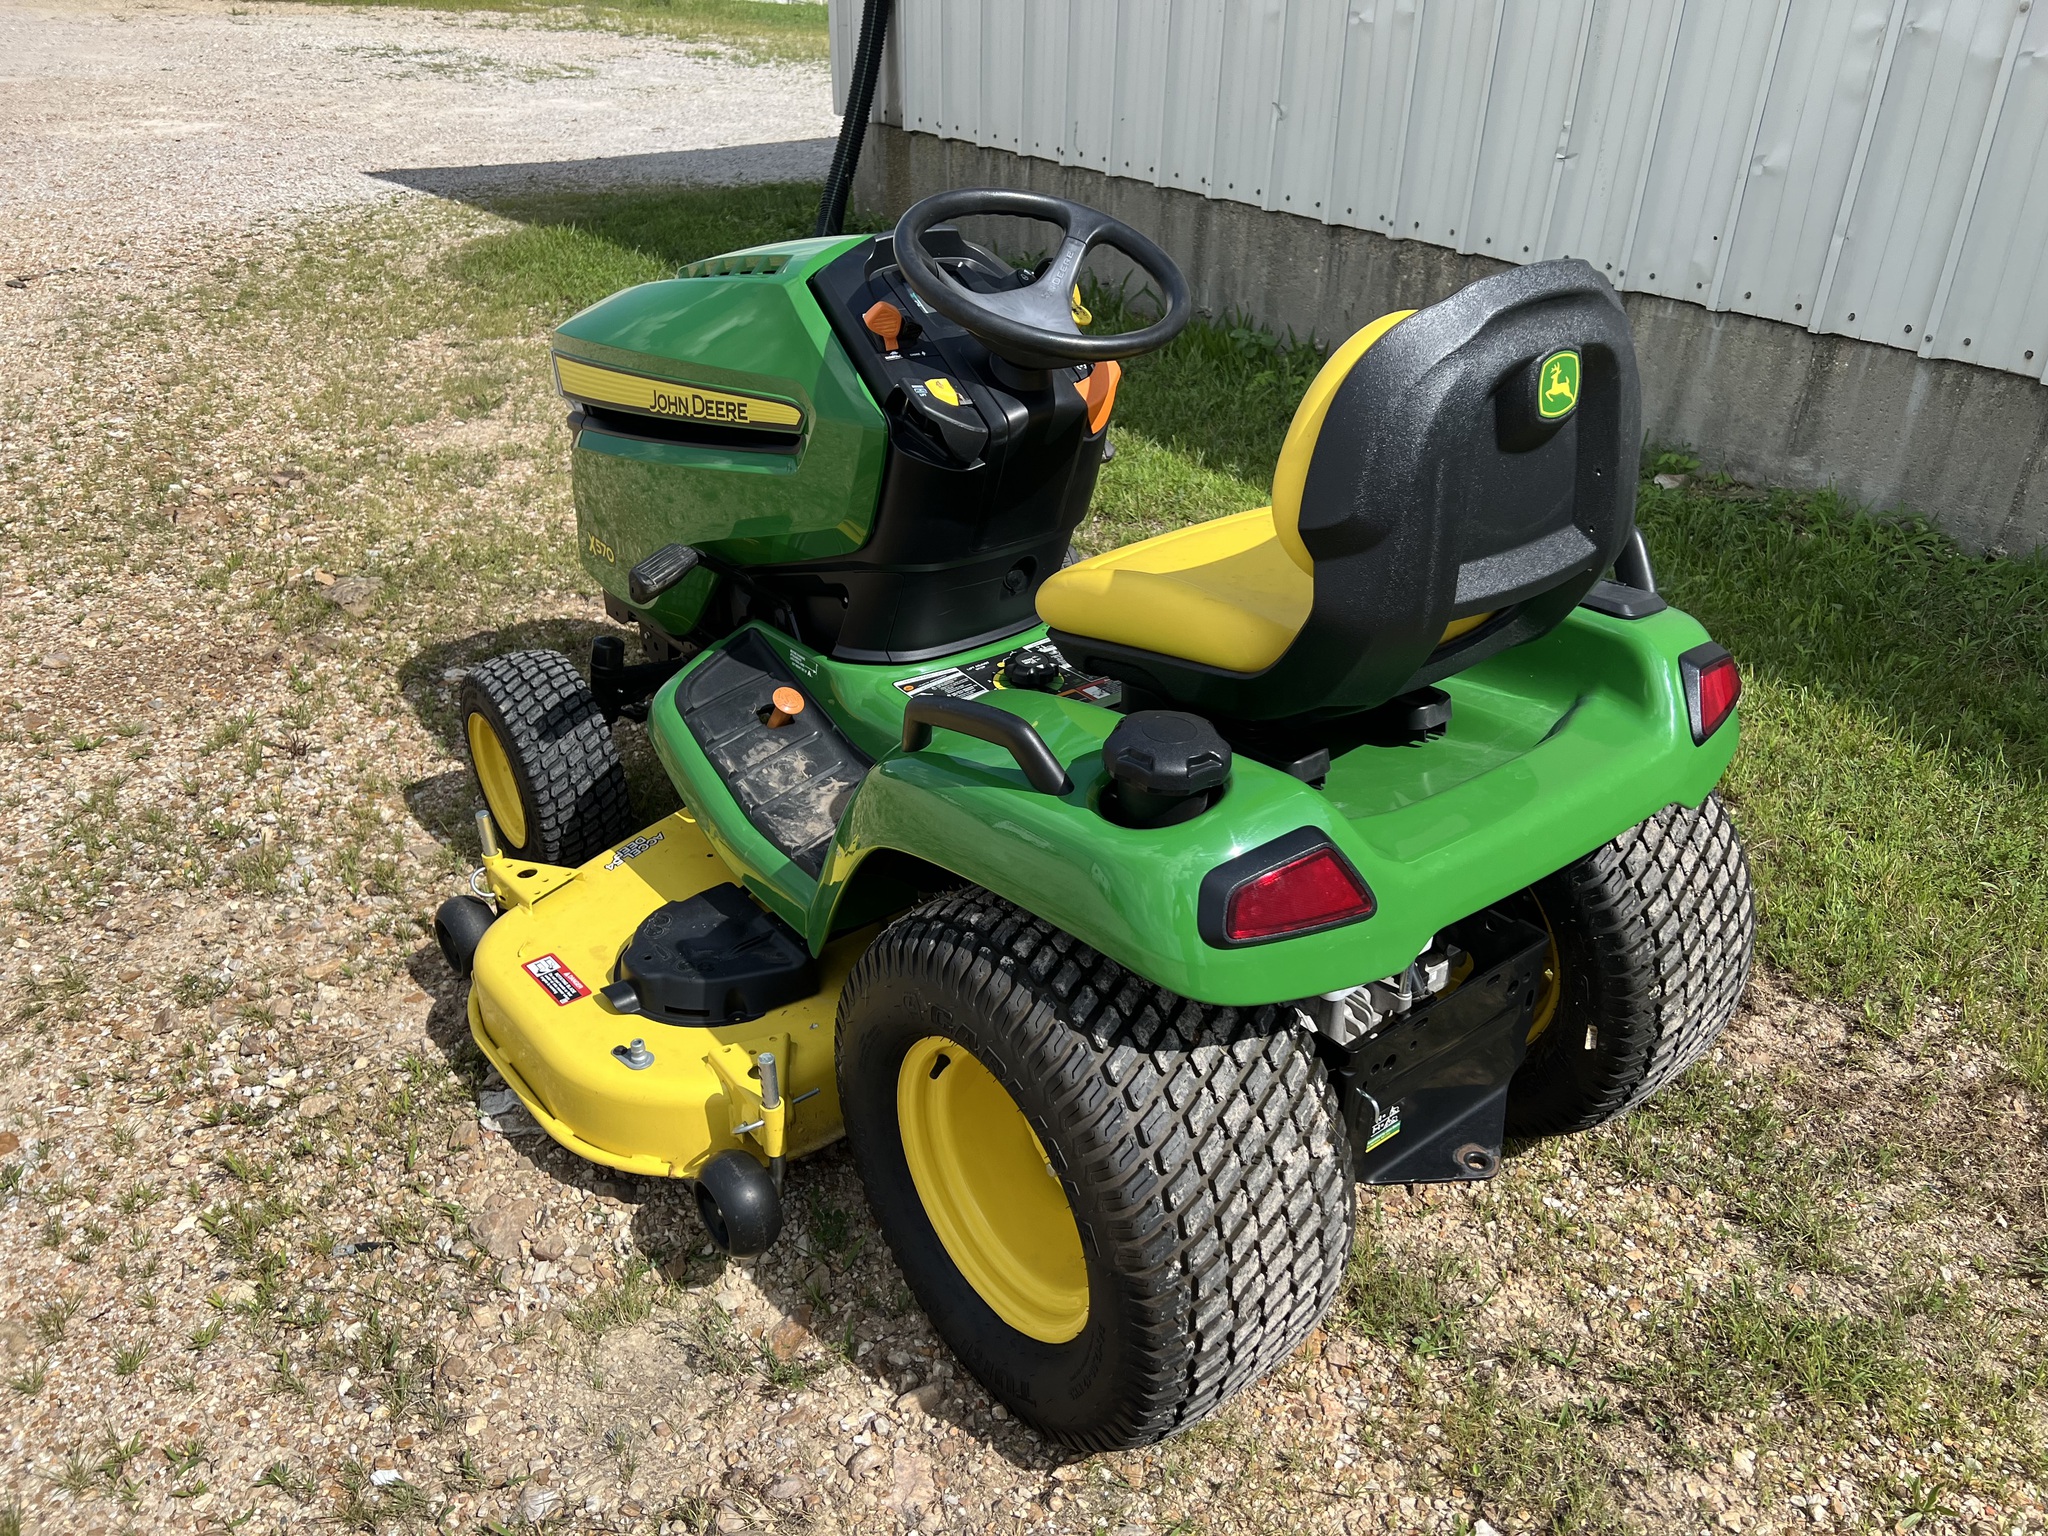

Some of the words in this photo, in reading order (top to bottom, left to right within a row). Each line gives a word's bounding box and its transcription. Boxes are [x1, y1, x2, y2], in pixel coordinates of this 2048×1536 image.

[1052, 250, 1074, 285] DEERE
[649, 389, 689, 415] JOHN
[692, 394, 748, 420] DEERE
[587, 531, 615, 563] X570
[622, 832, 664, 859] ACCEL
[930, 1003, 1102, 1259] CARLISLE
